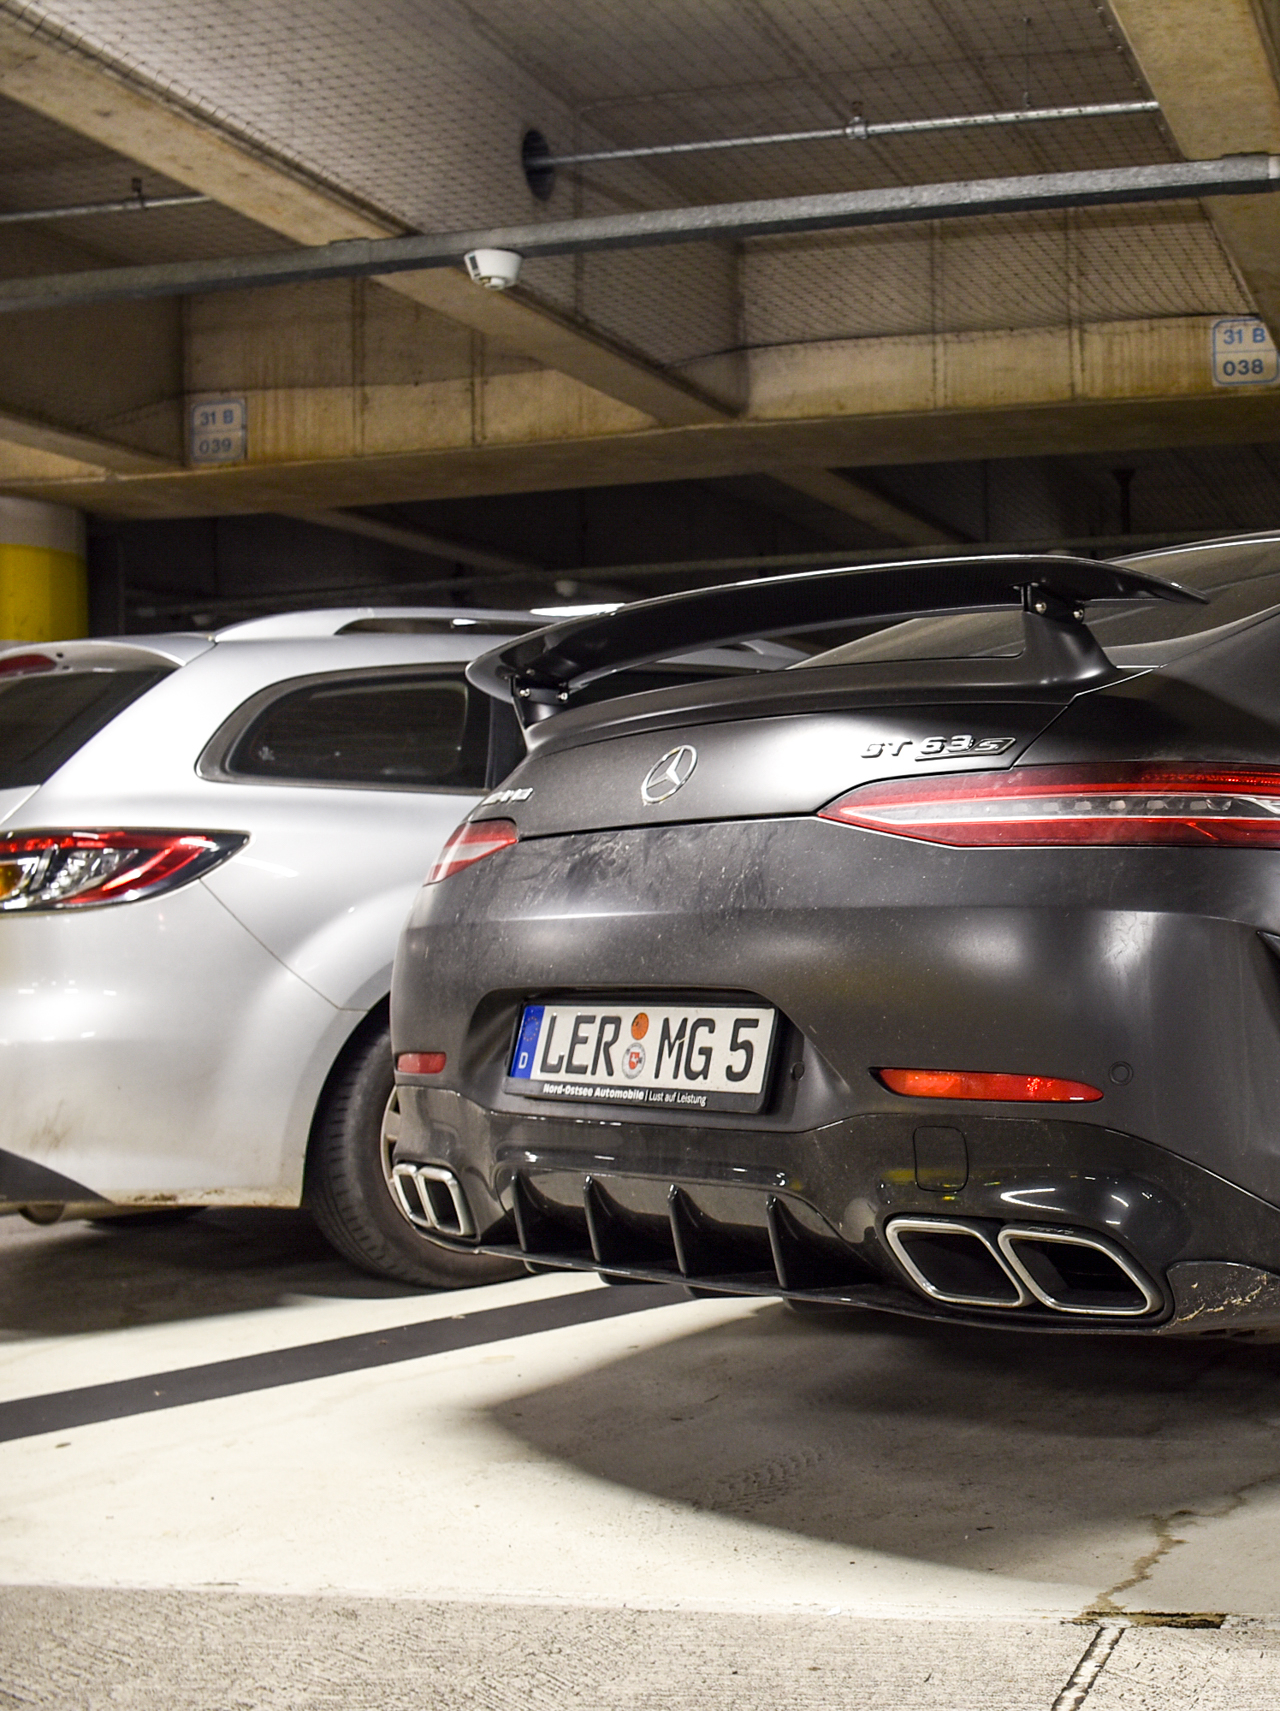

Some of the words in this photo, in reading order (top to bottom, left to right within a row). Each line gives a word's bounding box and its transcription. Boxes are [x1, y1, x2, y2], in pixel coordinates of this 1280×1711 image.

[1223, 329, 1244, 345] 31
[1252, 327, 1266, 343] B
[1223, 358, 1264, 376] 038
[200, 411, 216, 426] 31
[199, 438, 232, 455] 039
[540, 1013, 622, 1077] LER
[654, 1016, 716, 1080] MG
[725, 1018, 760, 1083] 5
[518, 1052, 529, 1070] D
[542, 1083, 594, 1097] Nord-Ostsee
[593, 1086, 645, 1101] Automobile
[648, 1090, 665, 1103] Lust
[664, 1092, 677, 1103] auf
[677, 1092, 708, 1108] Leistung
